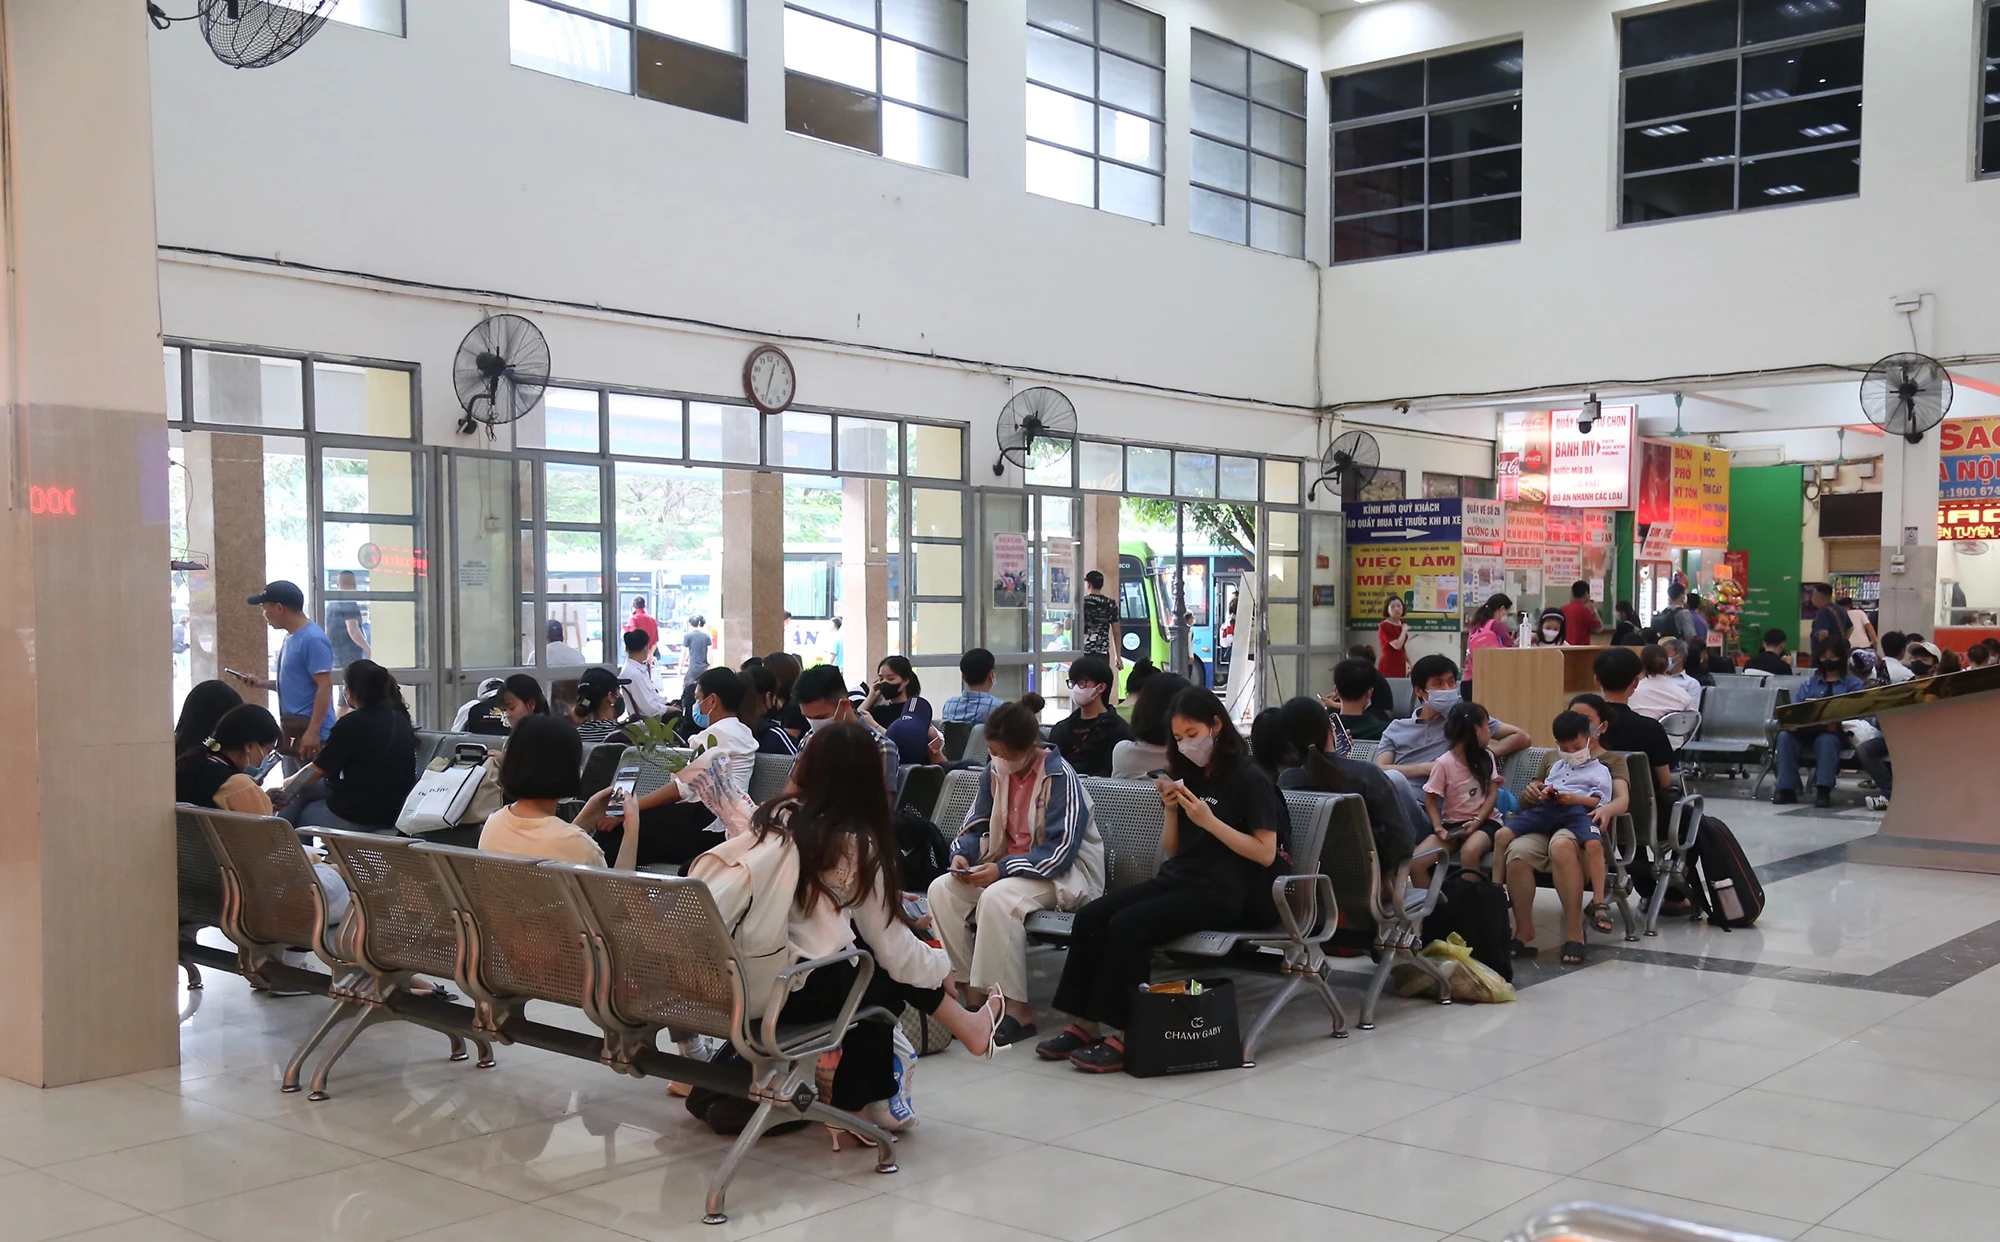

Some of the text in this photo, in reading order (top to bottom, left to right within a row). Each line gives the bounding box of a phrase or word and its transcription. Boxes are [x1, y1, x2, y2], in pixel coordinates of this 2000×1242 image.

[1572, 492, 1593, 501] NHANH
[1363, 504, 1381, 514] KÍNH
[1414, 502, 1440, 513] KHÁCH
[1377, 518, 1393, 527] MUA
[1429, 517, 1441, 525] KHI
[1452, 516, 1462, 525] XE
[1490, 528, 1500, 537] AN
[1355, 554, 1456, 570] VIỆC LÀM
[1164, 1026, 1222, 1040] CHAMY GABY
